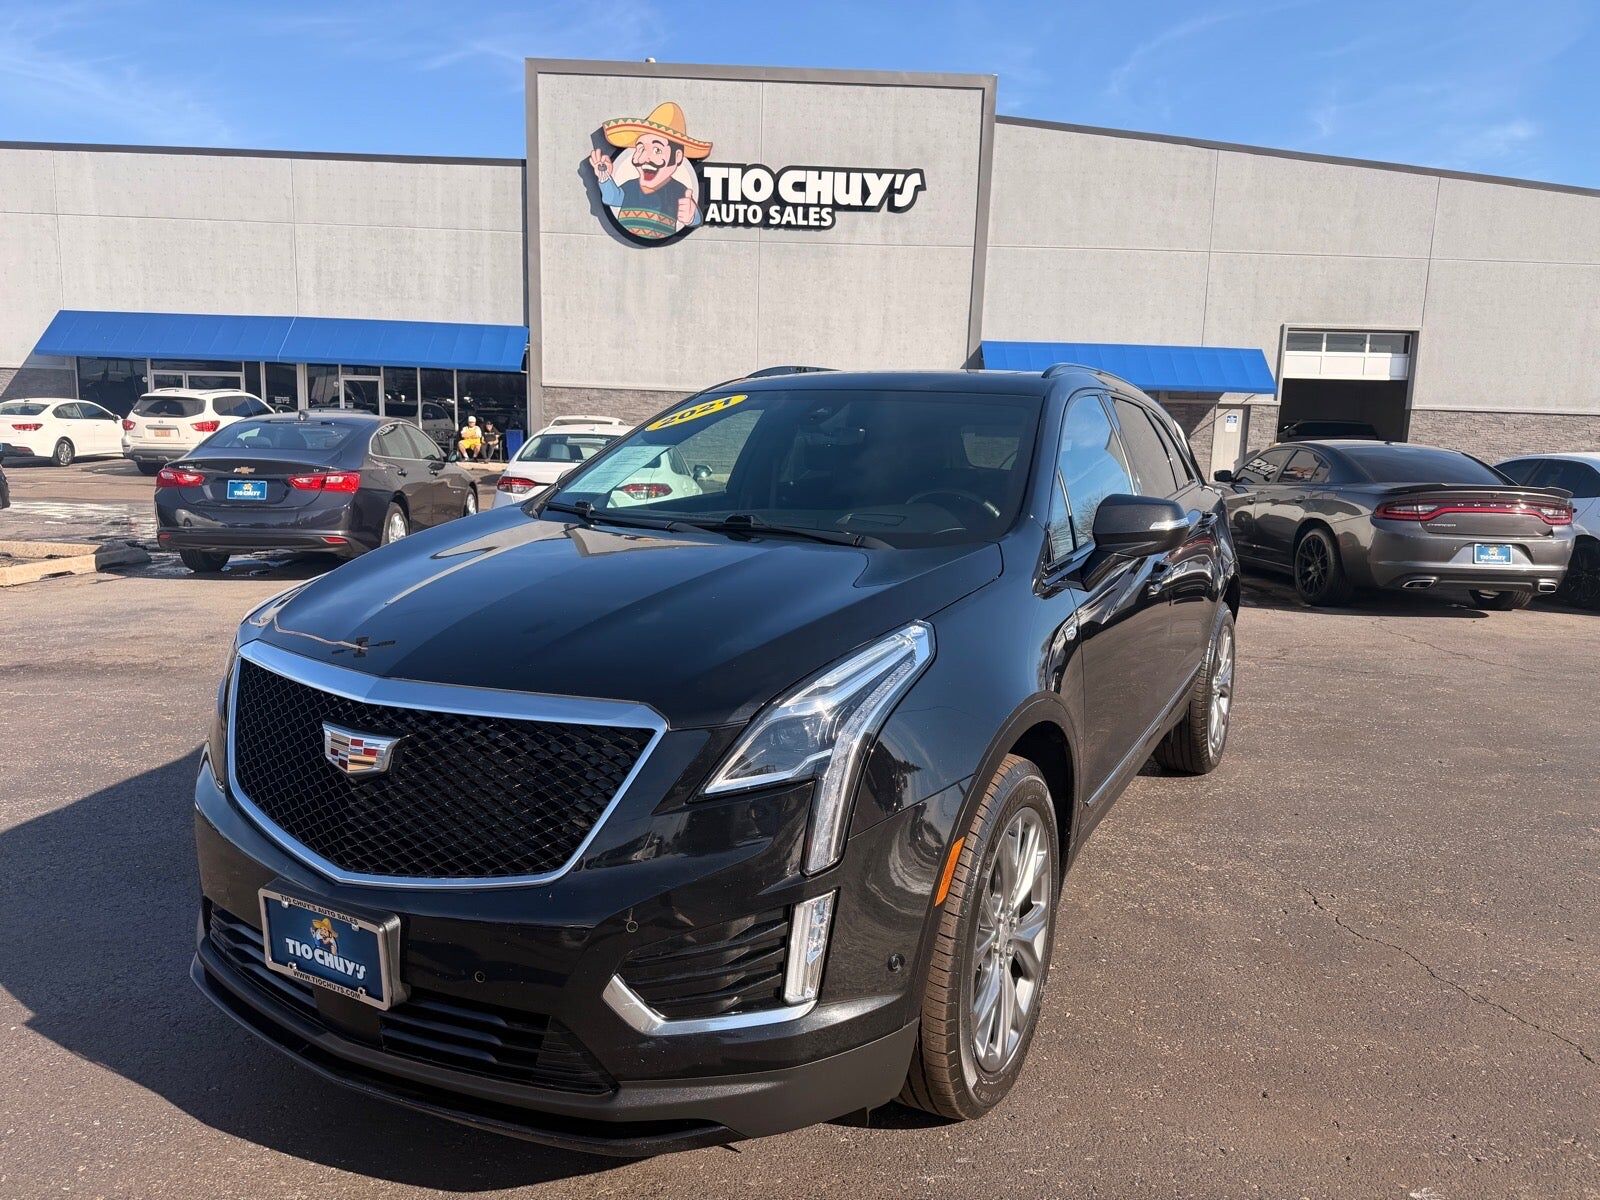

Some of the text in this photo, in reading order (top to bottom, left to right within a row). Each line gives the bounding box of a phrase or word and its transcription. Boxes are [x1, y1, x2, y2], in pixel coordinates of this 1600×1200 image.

[704, 166, 922, 208] TIO CHUY'S
[705, 203, 833, 227] AUTO SALES
[657, 397, 733, 429] 2021
[318, 907, 336, 918] AUTO
[336, 913, 359, 926] SALES
[285, 937, 367, 980] TIO CHUY'S
